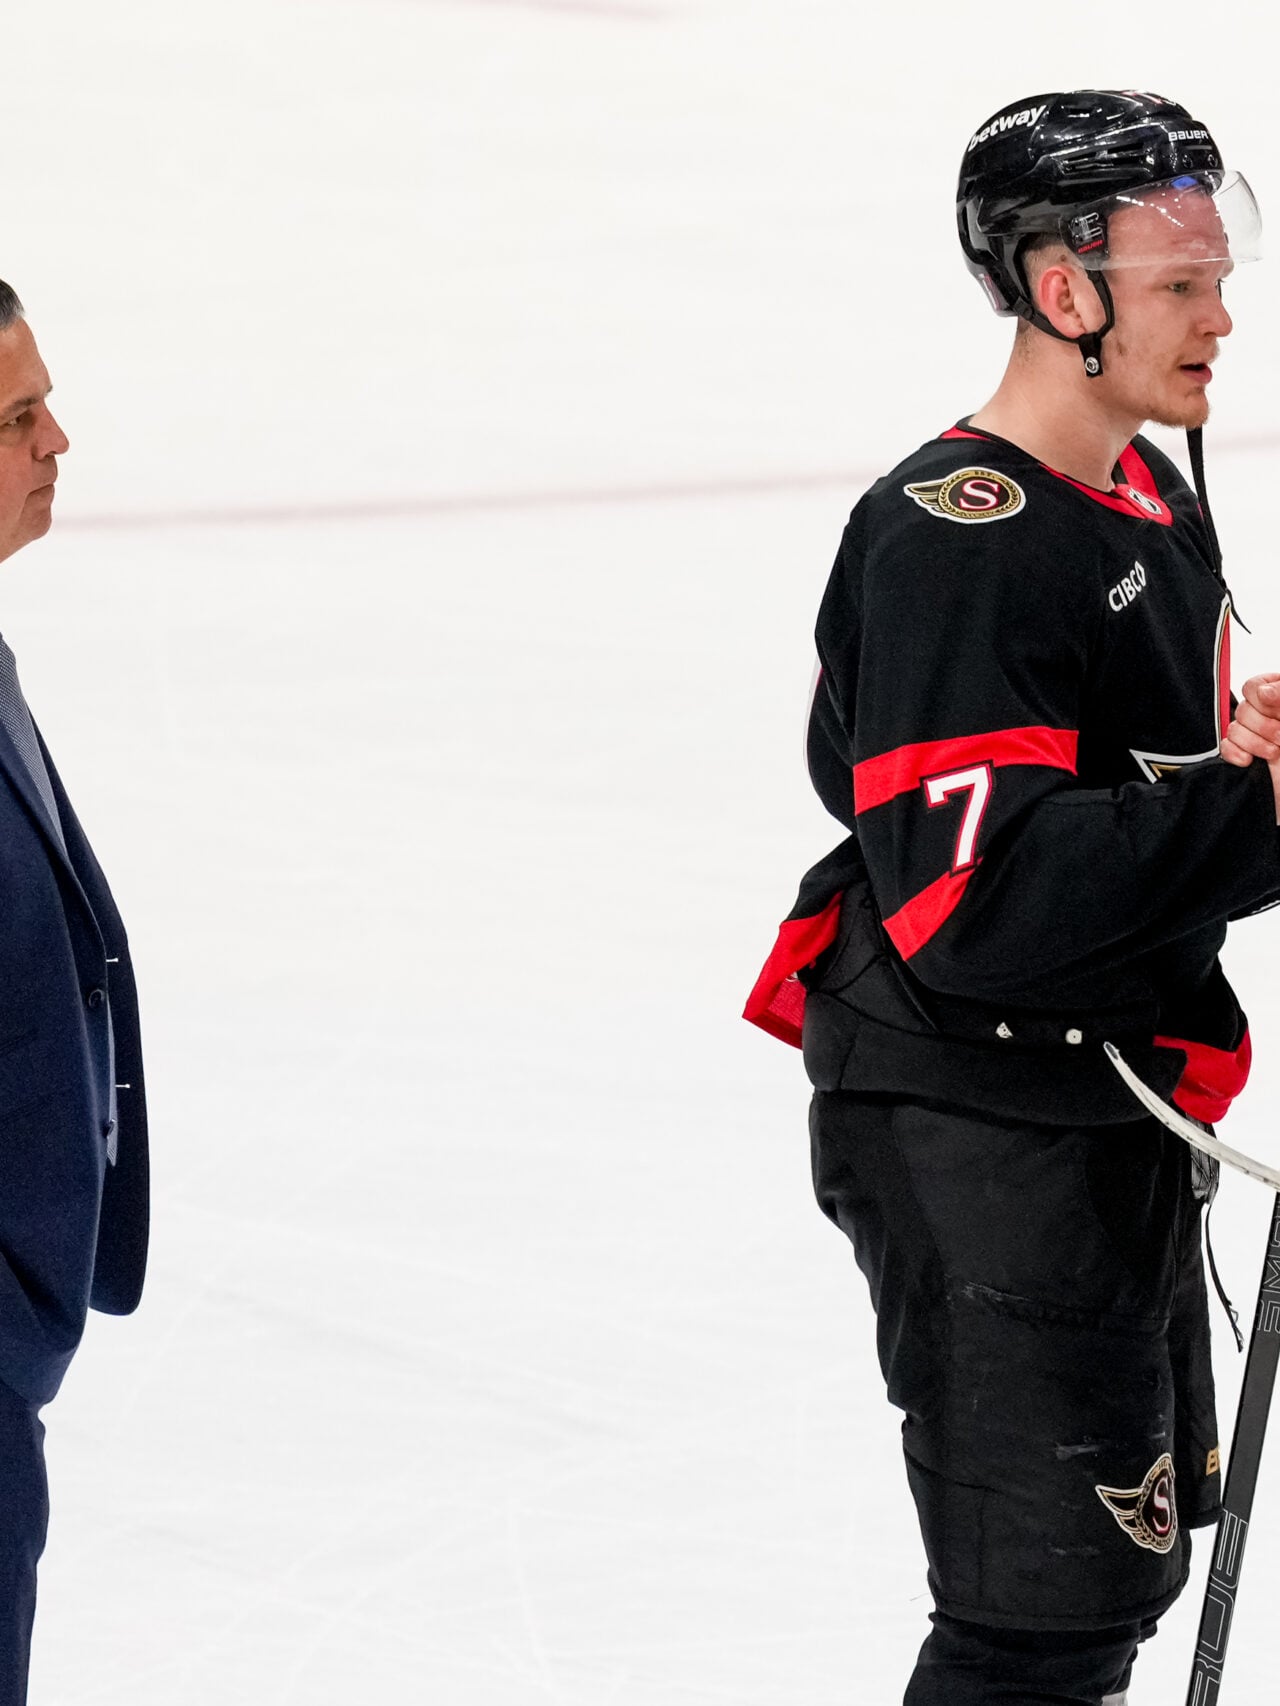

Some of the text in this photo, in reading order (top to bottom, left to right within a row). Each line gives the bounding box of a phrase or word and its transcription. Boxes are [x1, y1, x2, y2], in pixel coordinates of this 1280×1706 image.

[967, 104, 1047, 152] betway
[1167, 129, 1209, 142] BAUER
[958, 478, 1000, 511] S
[1108, 569, 1142, 612] CIBC
[923, 763, 992, 873] 7
